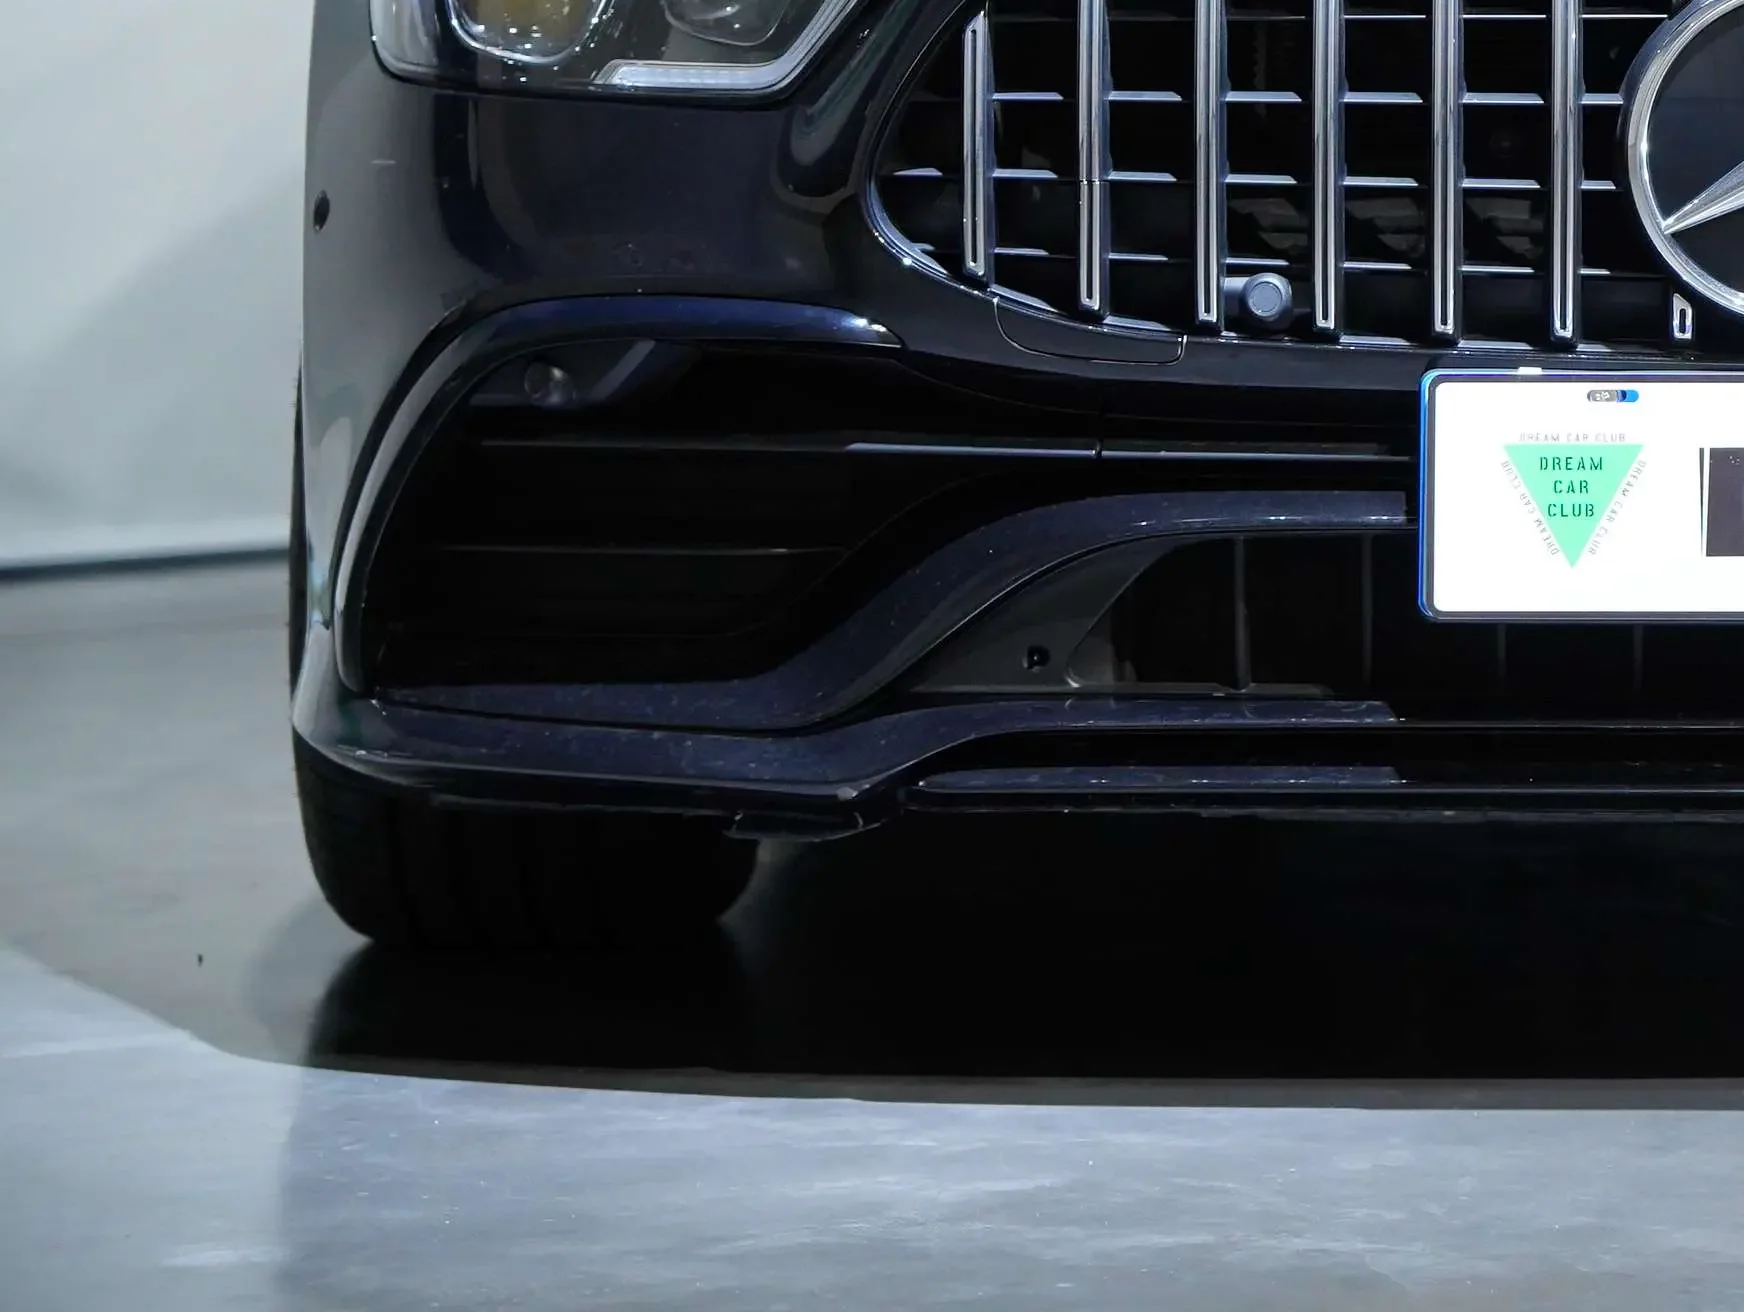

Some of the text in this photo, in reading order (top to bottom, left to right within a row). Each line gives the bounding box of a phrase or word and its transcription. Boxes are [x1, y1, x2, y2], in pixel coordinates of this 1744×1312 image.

[1520, 433, 1626, 442] DREAM CAR CLUB
[1539, 456, 1604, 471] DREAM
[1553, 479, 1589, 494] CAR
[1547, 503, 1595, 517] CLUB
